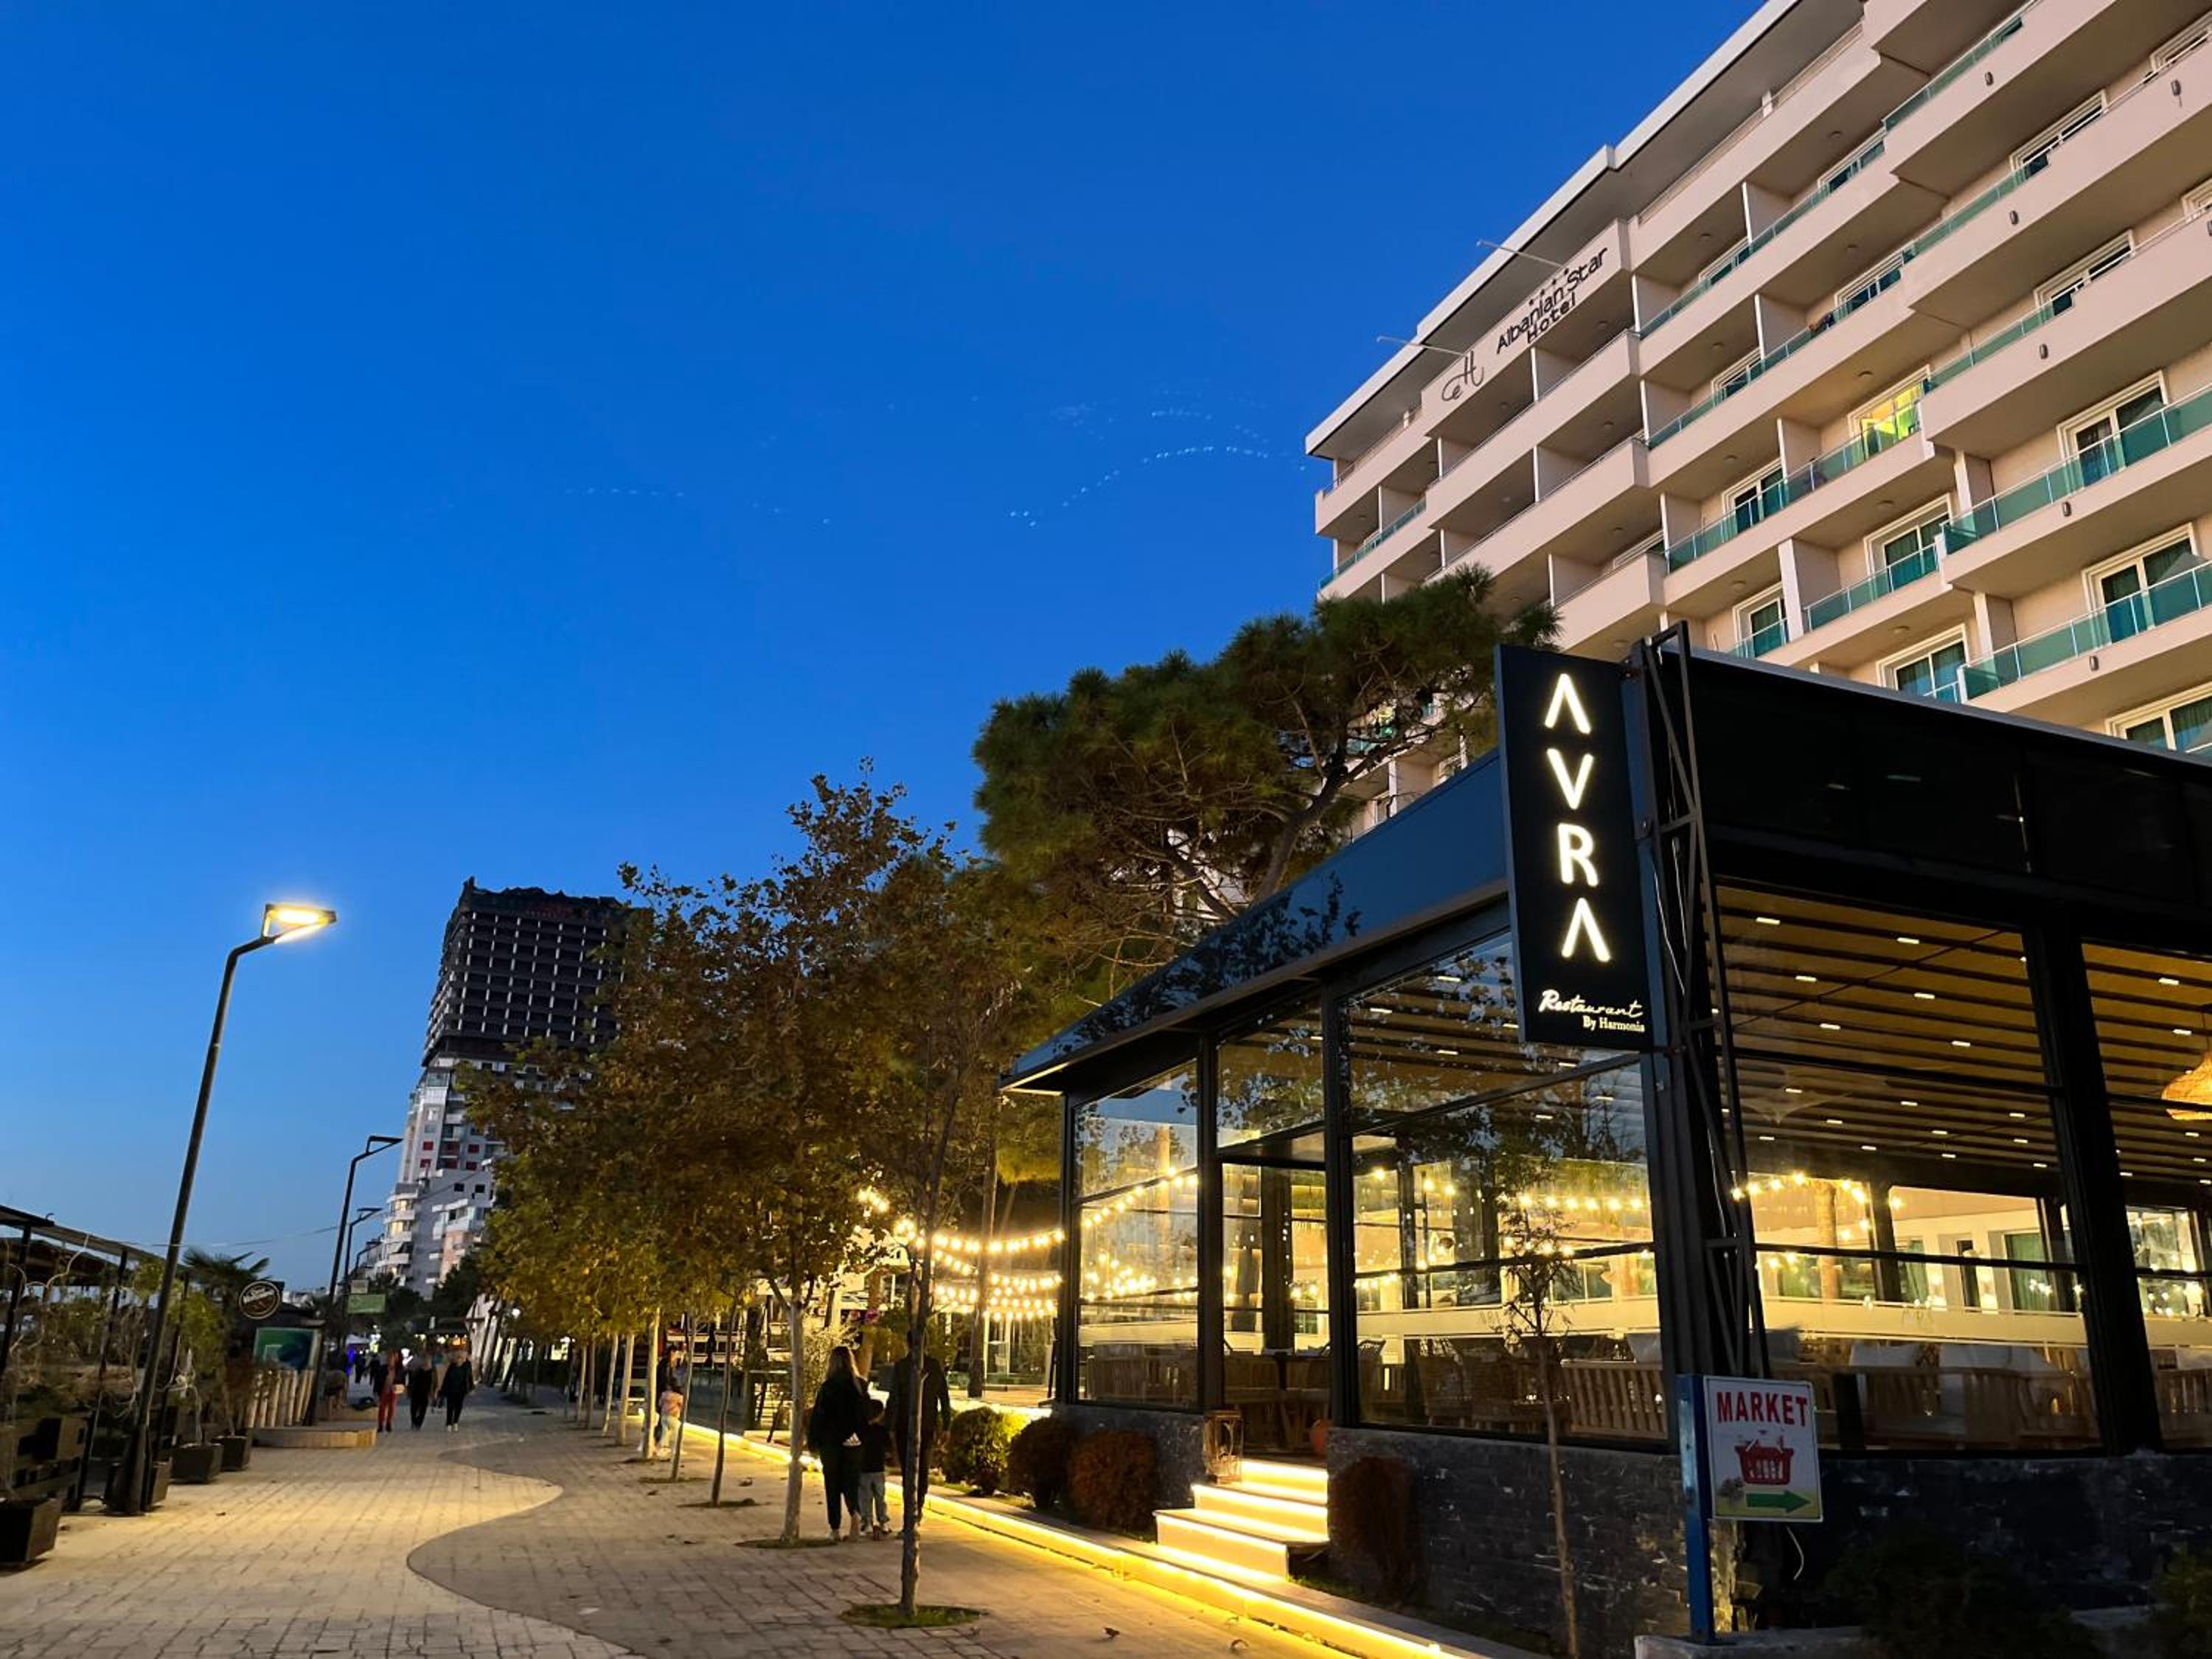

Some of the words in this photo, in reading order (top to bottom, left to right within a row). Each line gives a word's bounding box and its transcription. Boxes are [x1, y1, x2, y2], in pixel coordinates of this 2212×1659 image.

[1497, 286, 1564, 354] Albanian
[1567, 247, 1607, 292] Star
[1527, 291, 1576, 344] Hotel
[1543, 672, 1613, 963] AVRA
[1538, 989, 1644, 1018] Restaurant
[1582, 1015, 1596, 1031] By
[1599, 1017, 1645, 1032] Harmonia
[1716, 1391, 1809, 1427] MARKET
